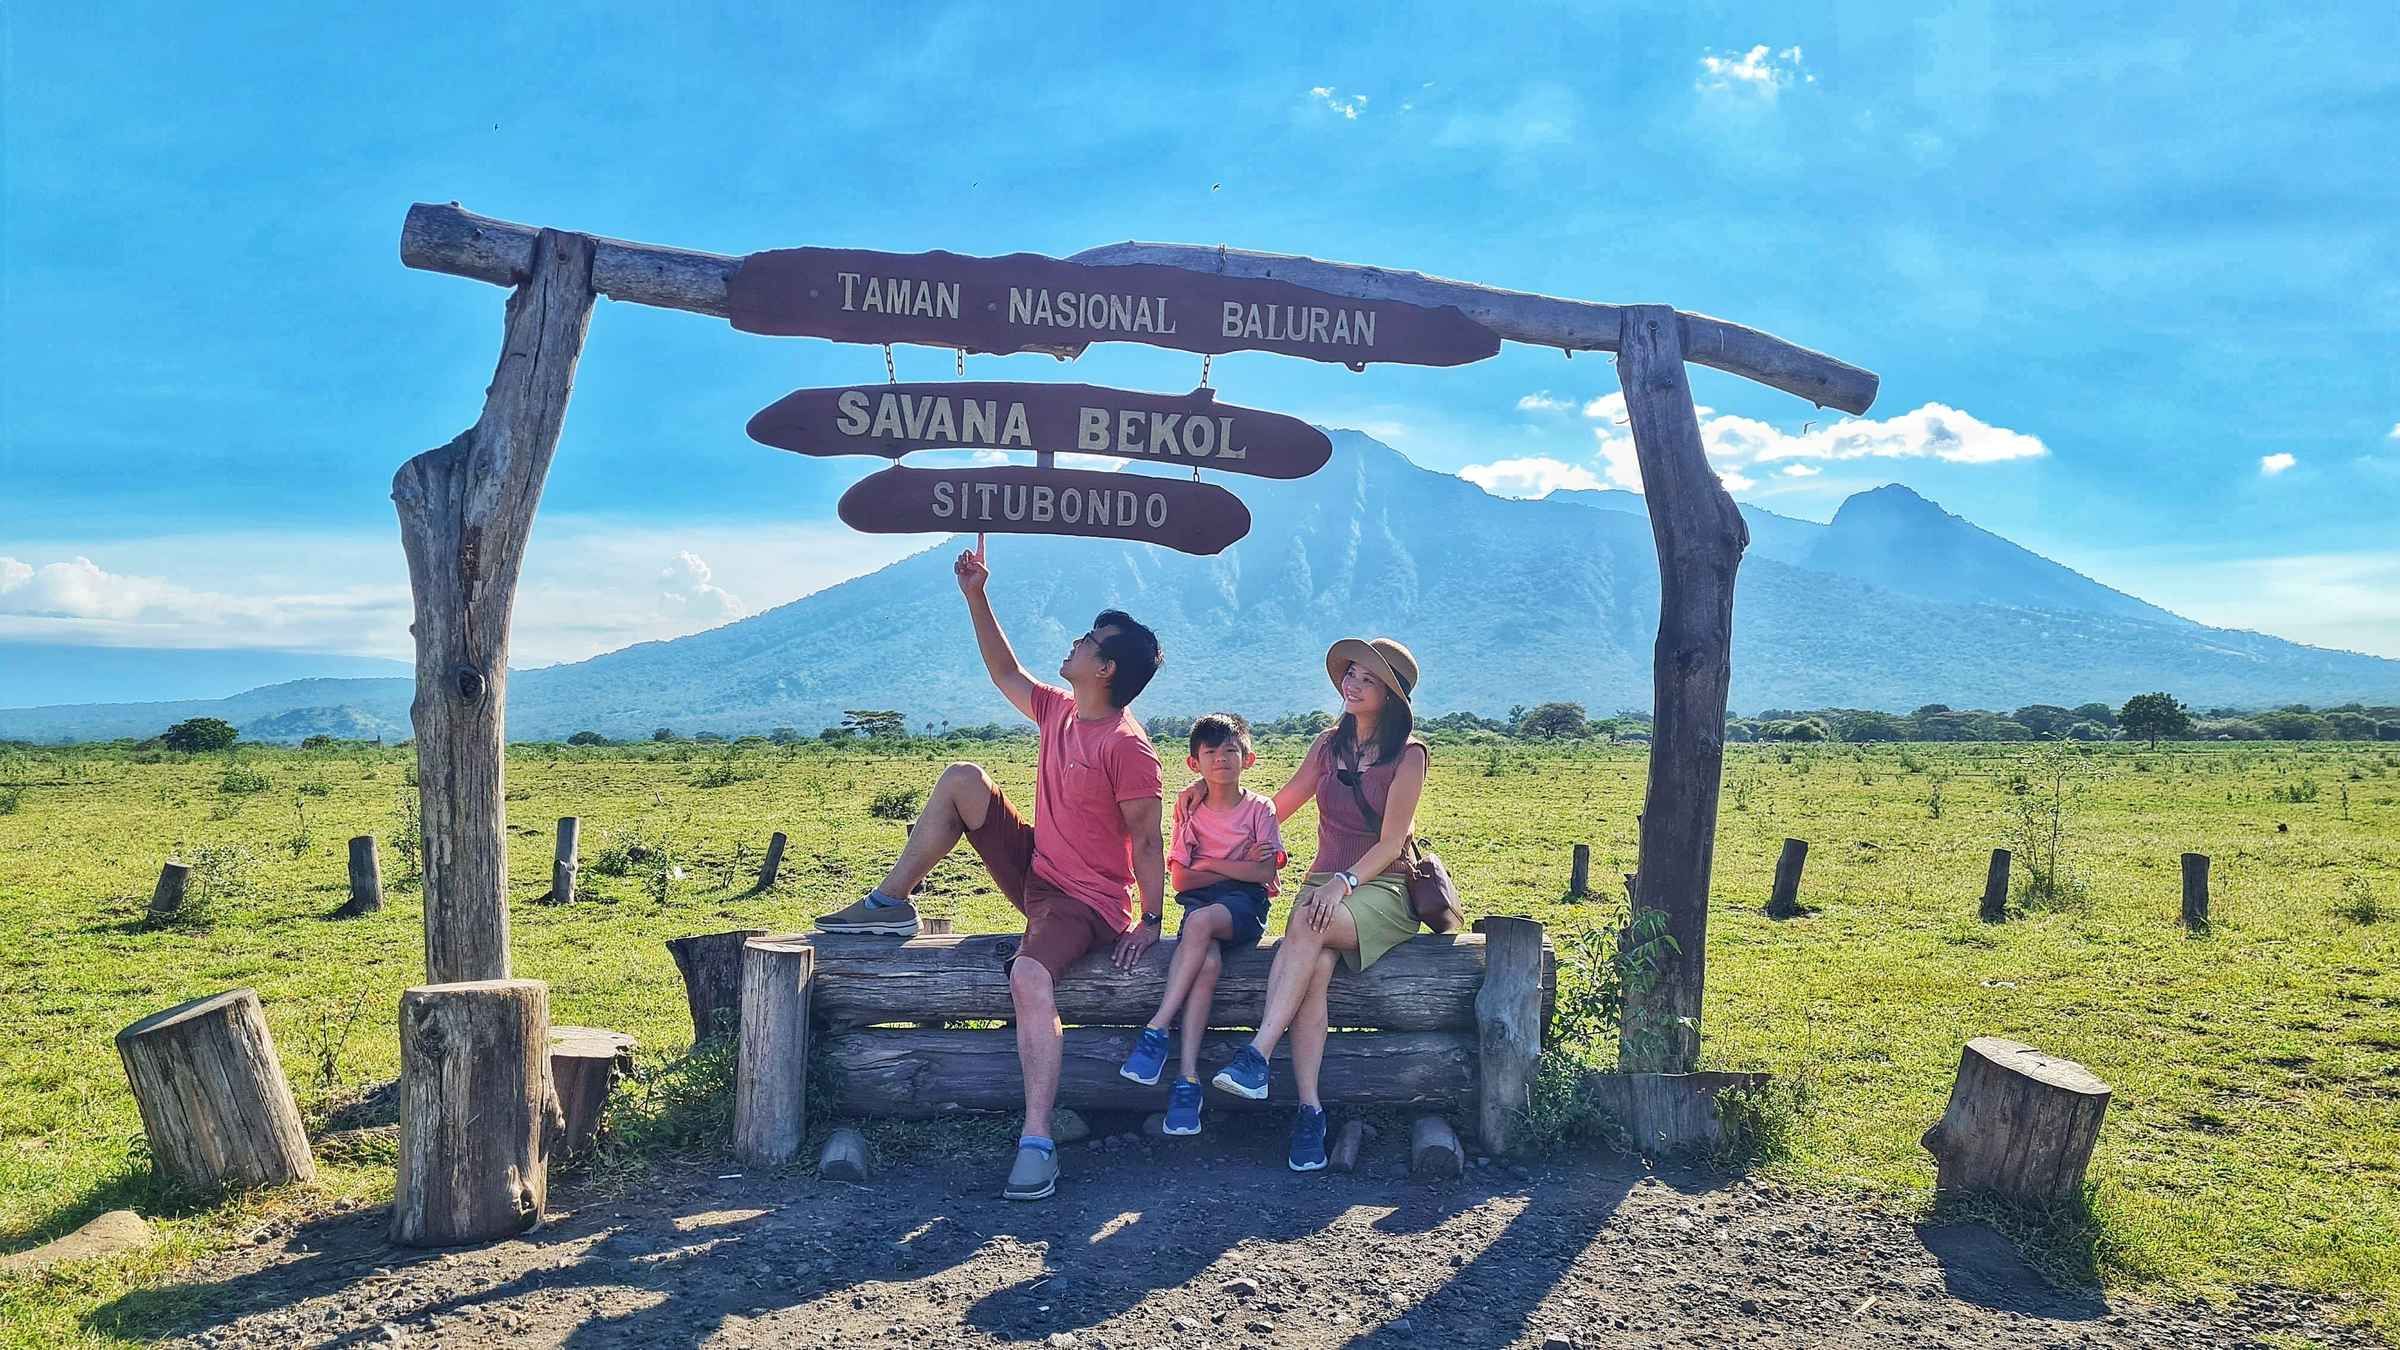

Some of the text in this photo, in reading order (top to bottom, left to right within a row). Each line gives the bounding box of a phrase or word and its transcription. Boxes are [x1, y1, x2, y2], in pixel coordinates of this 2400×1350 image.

[837, 272, 1376, 347] TAMAN NASIONAL BALURAN
[836, 390, 1247, 459] SAVANA BEKOL
[931, 481, 1168, 528] SITUBONDO
